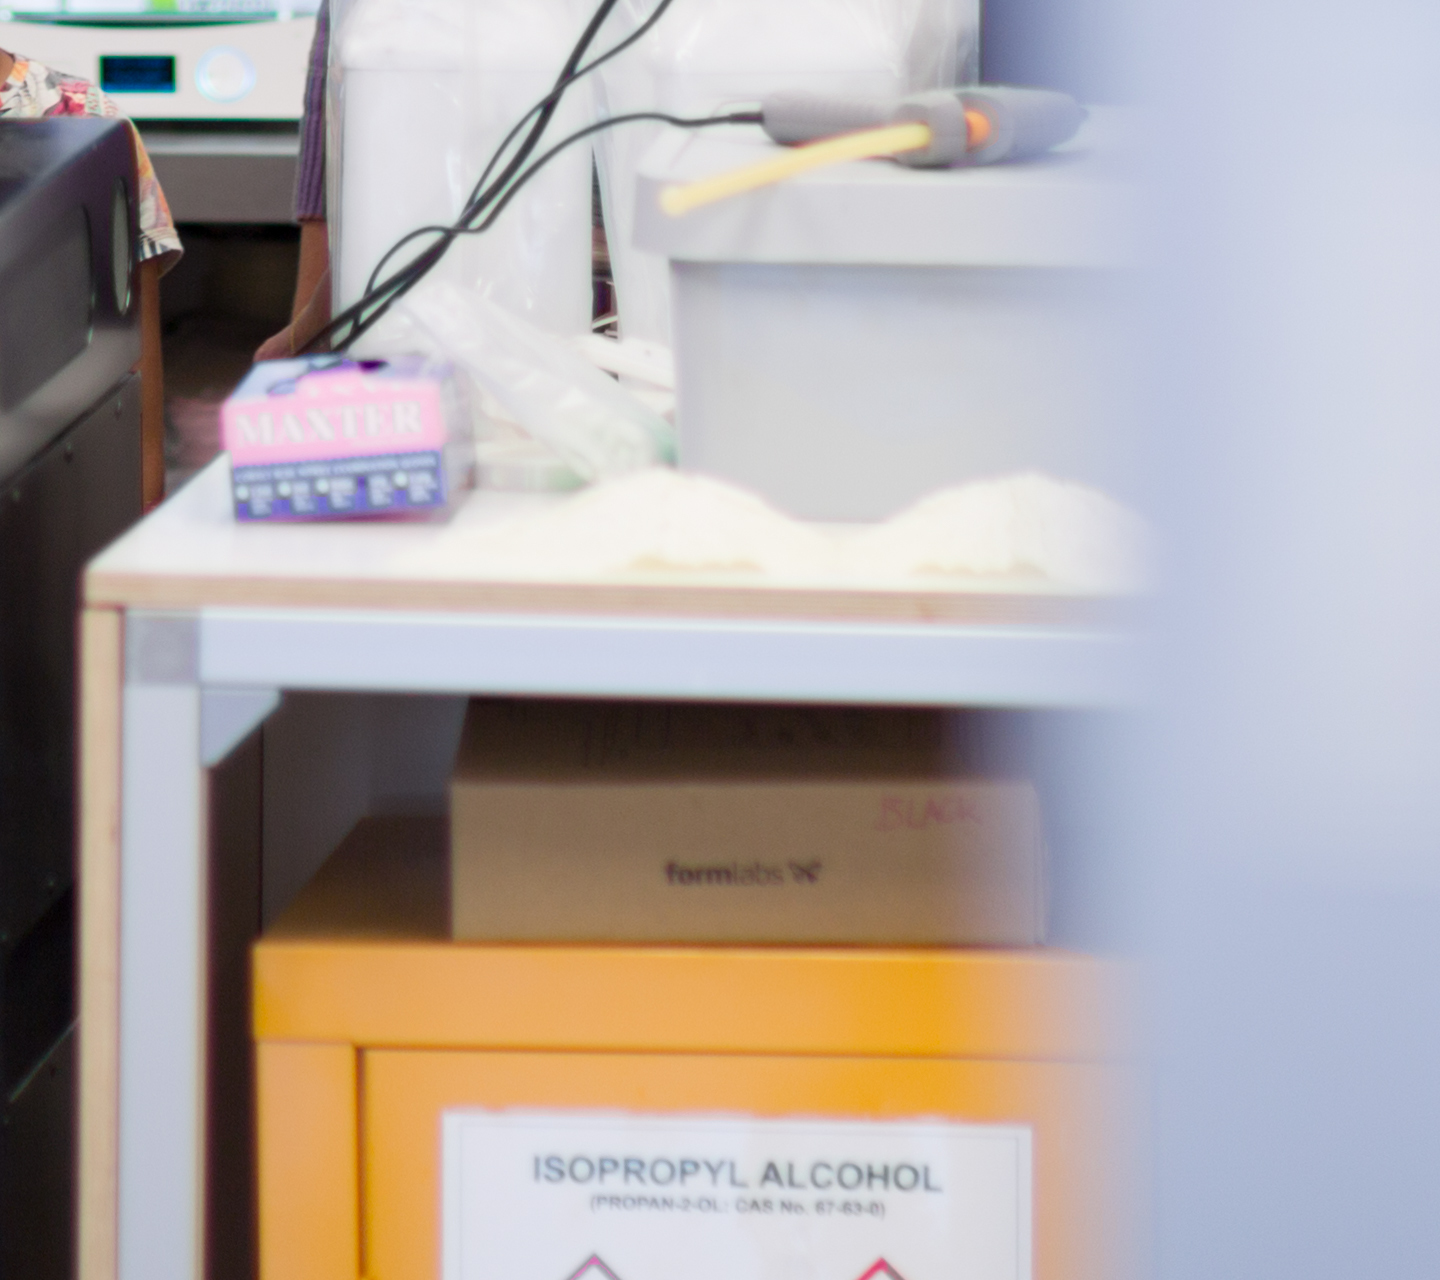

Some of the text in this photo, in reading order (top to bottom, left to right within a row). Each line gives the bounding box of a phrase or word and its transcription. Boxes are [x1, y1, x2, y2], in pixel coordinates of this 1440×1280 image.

[234, 399, 426, 447] MAXTER
[666, 859, 784, 886] formlabs
[533, 1155, 943, 1193] ISOPROPYL ALCOHOL
[589, 1195, 728, 1215] (PROPAN-2-OL:
[735, 1199, 773, 1215] CAS
